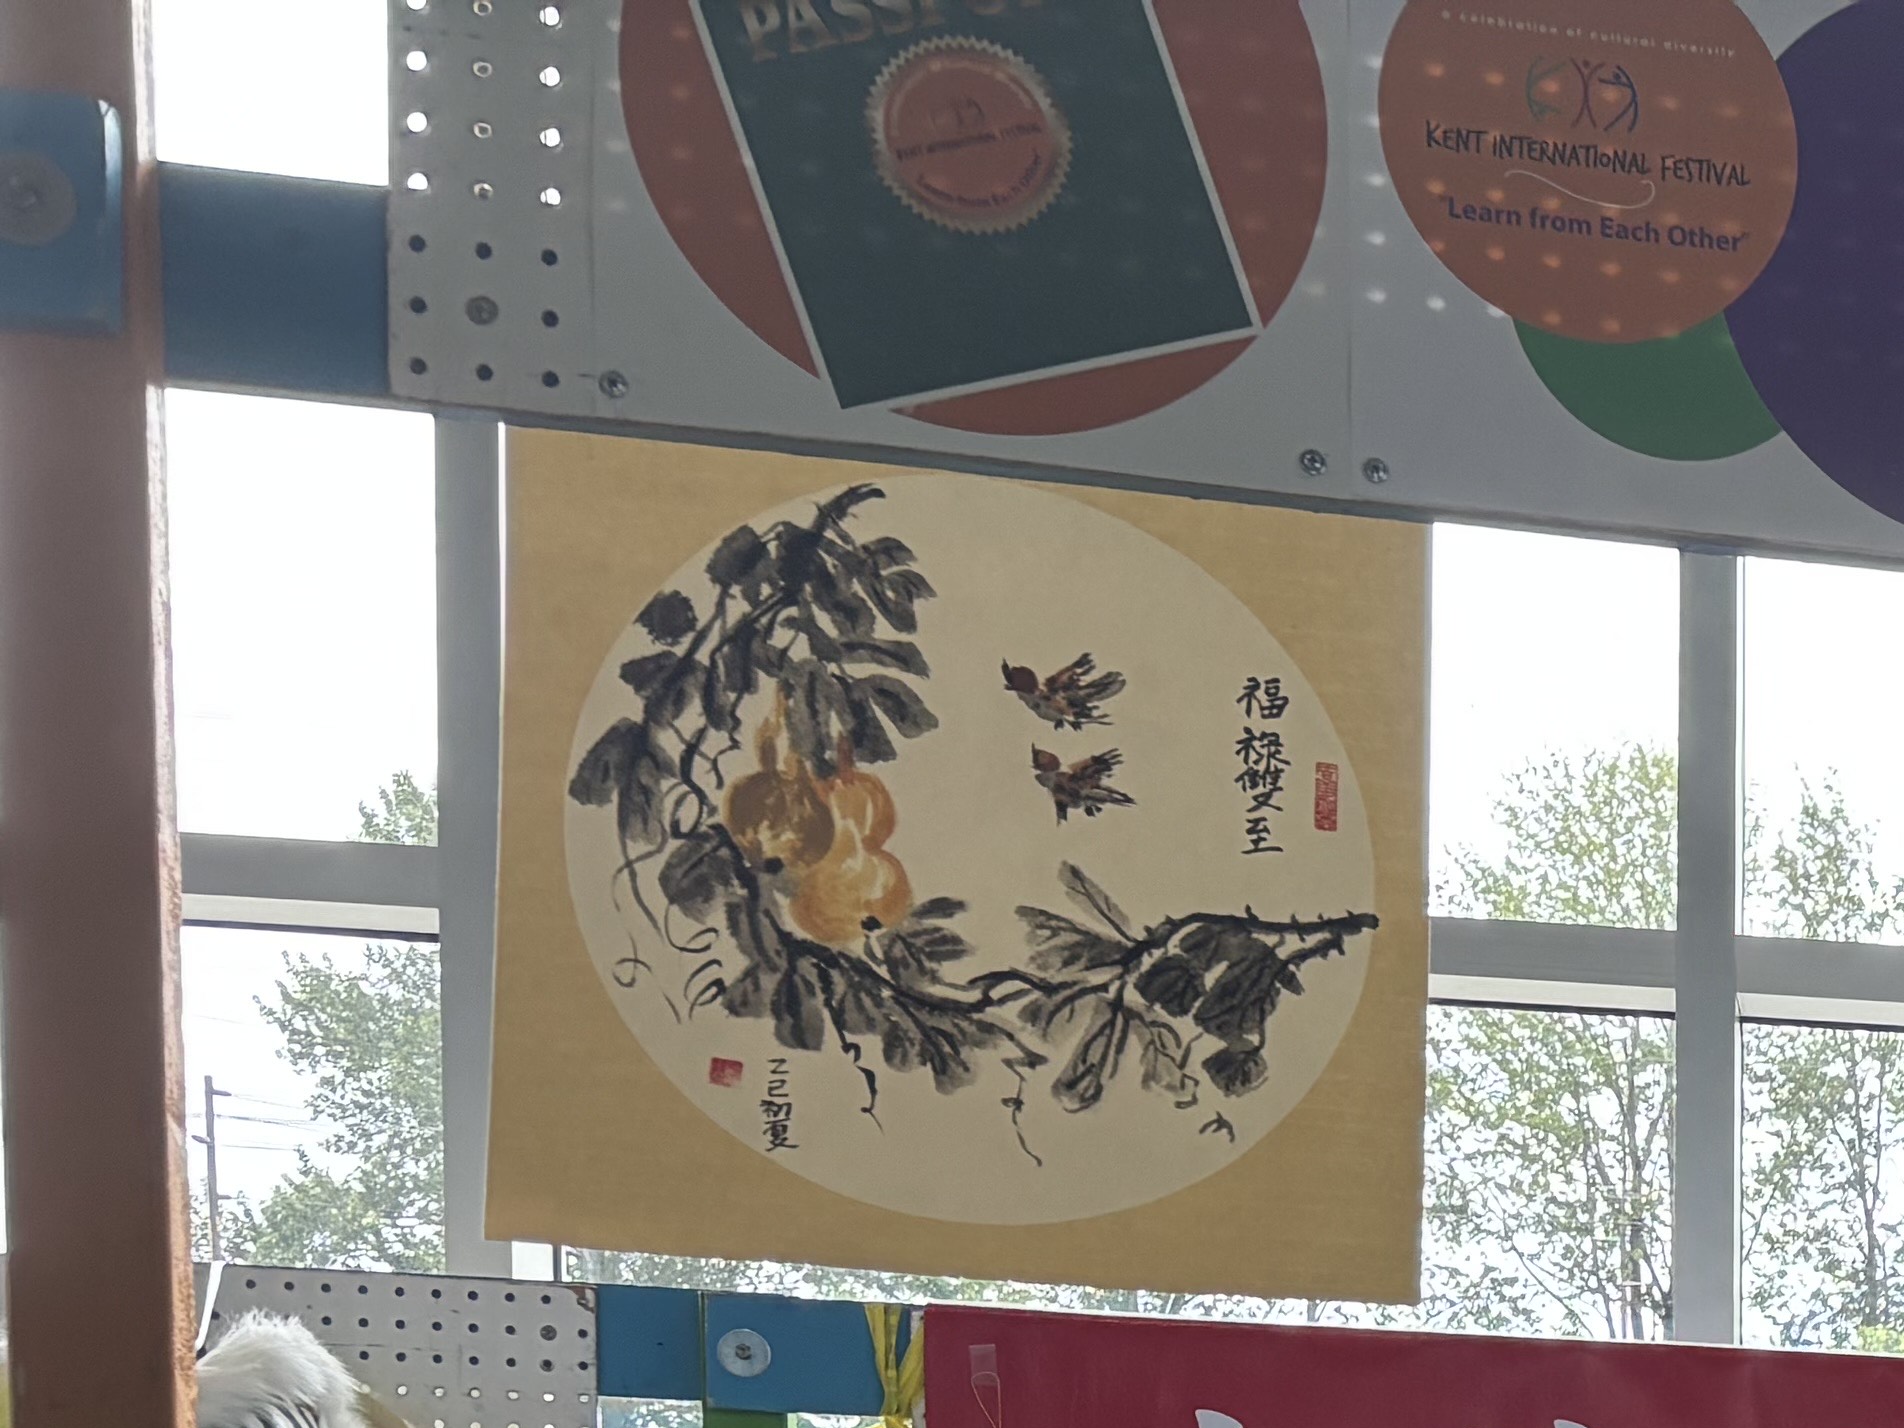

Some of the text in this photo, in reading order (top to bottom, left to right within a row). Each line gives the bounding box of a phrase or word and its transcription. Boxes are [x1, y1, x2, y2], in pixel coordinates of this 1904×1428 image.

[1459, 11, 1558, 36] celebration
[1589, 29, 1656, 48] cultural
[1663, 39, 1738, 59] diversity
[1425, 119, 1751, 188] KENT INTERNATIONAL FESTIVAL
[1530, 207, 1602, 237] from
[1600, 217, 1660, 245] Each
